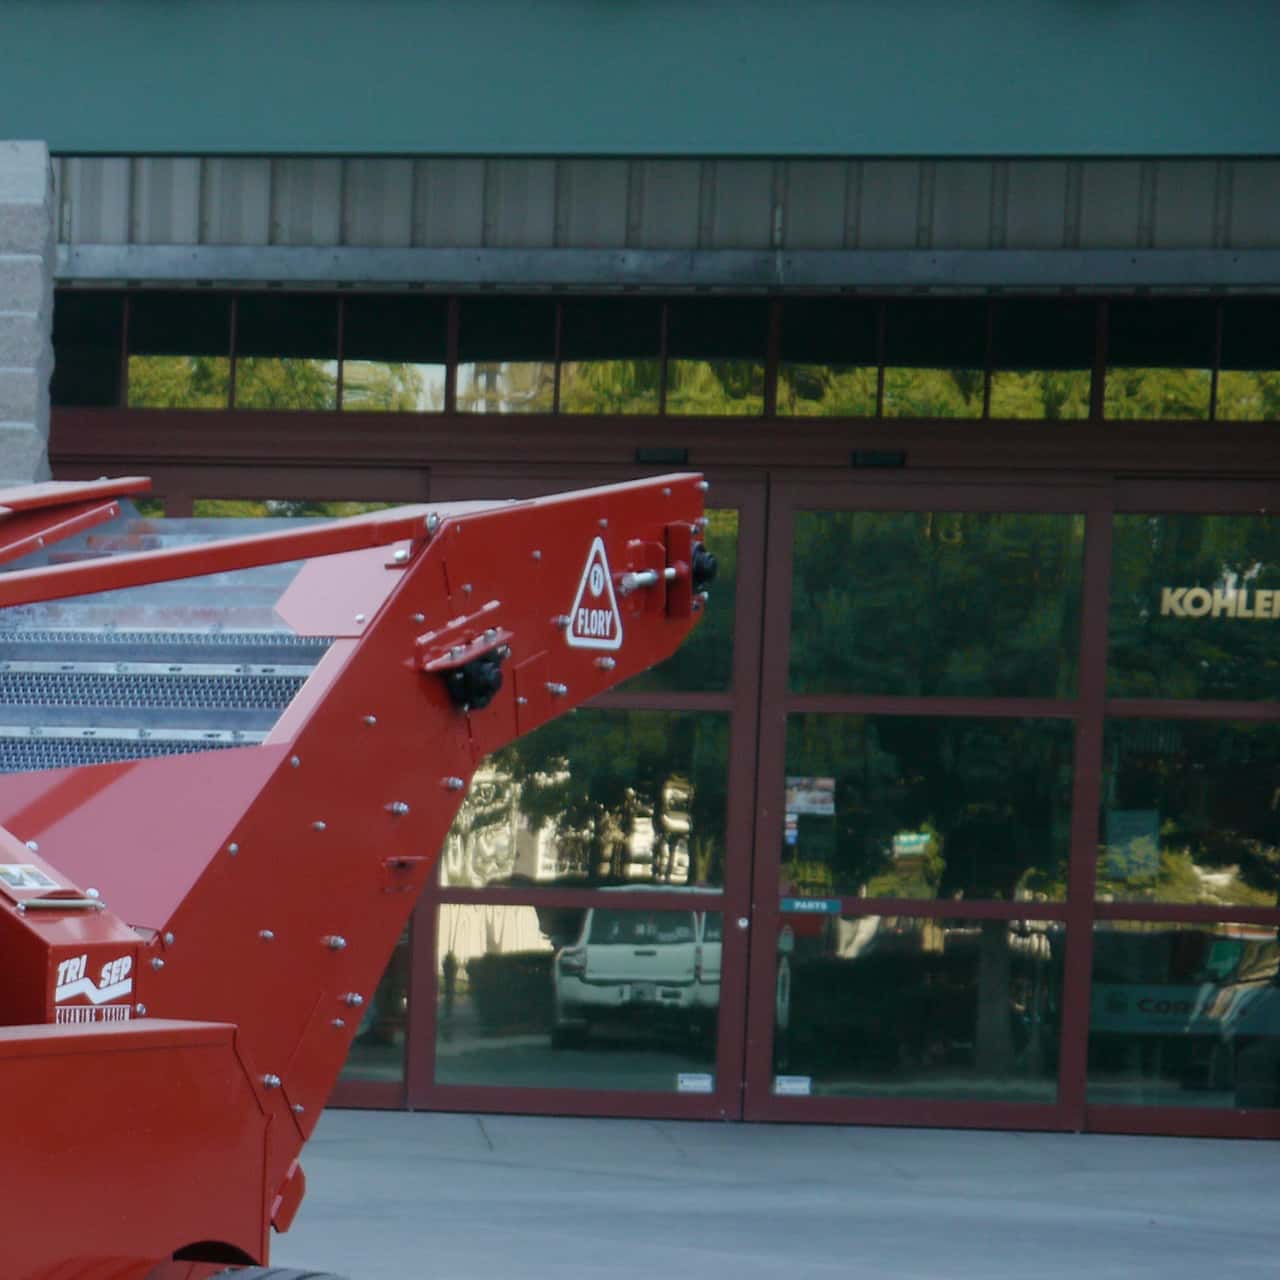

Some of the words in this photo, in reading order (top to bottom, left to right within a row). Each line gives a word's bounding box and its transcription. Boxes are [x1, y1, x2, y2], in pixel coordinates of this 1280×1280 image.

[577, 607, 613, 636] FLORY
[57, 954, 88, 987] TRI
[99, 955, 133, 988] SEP
